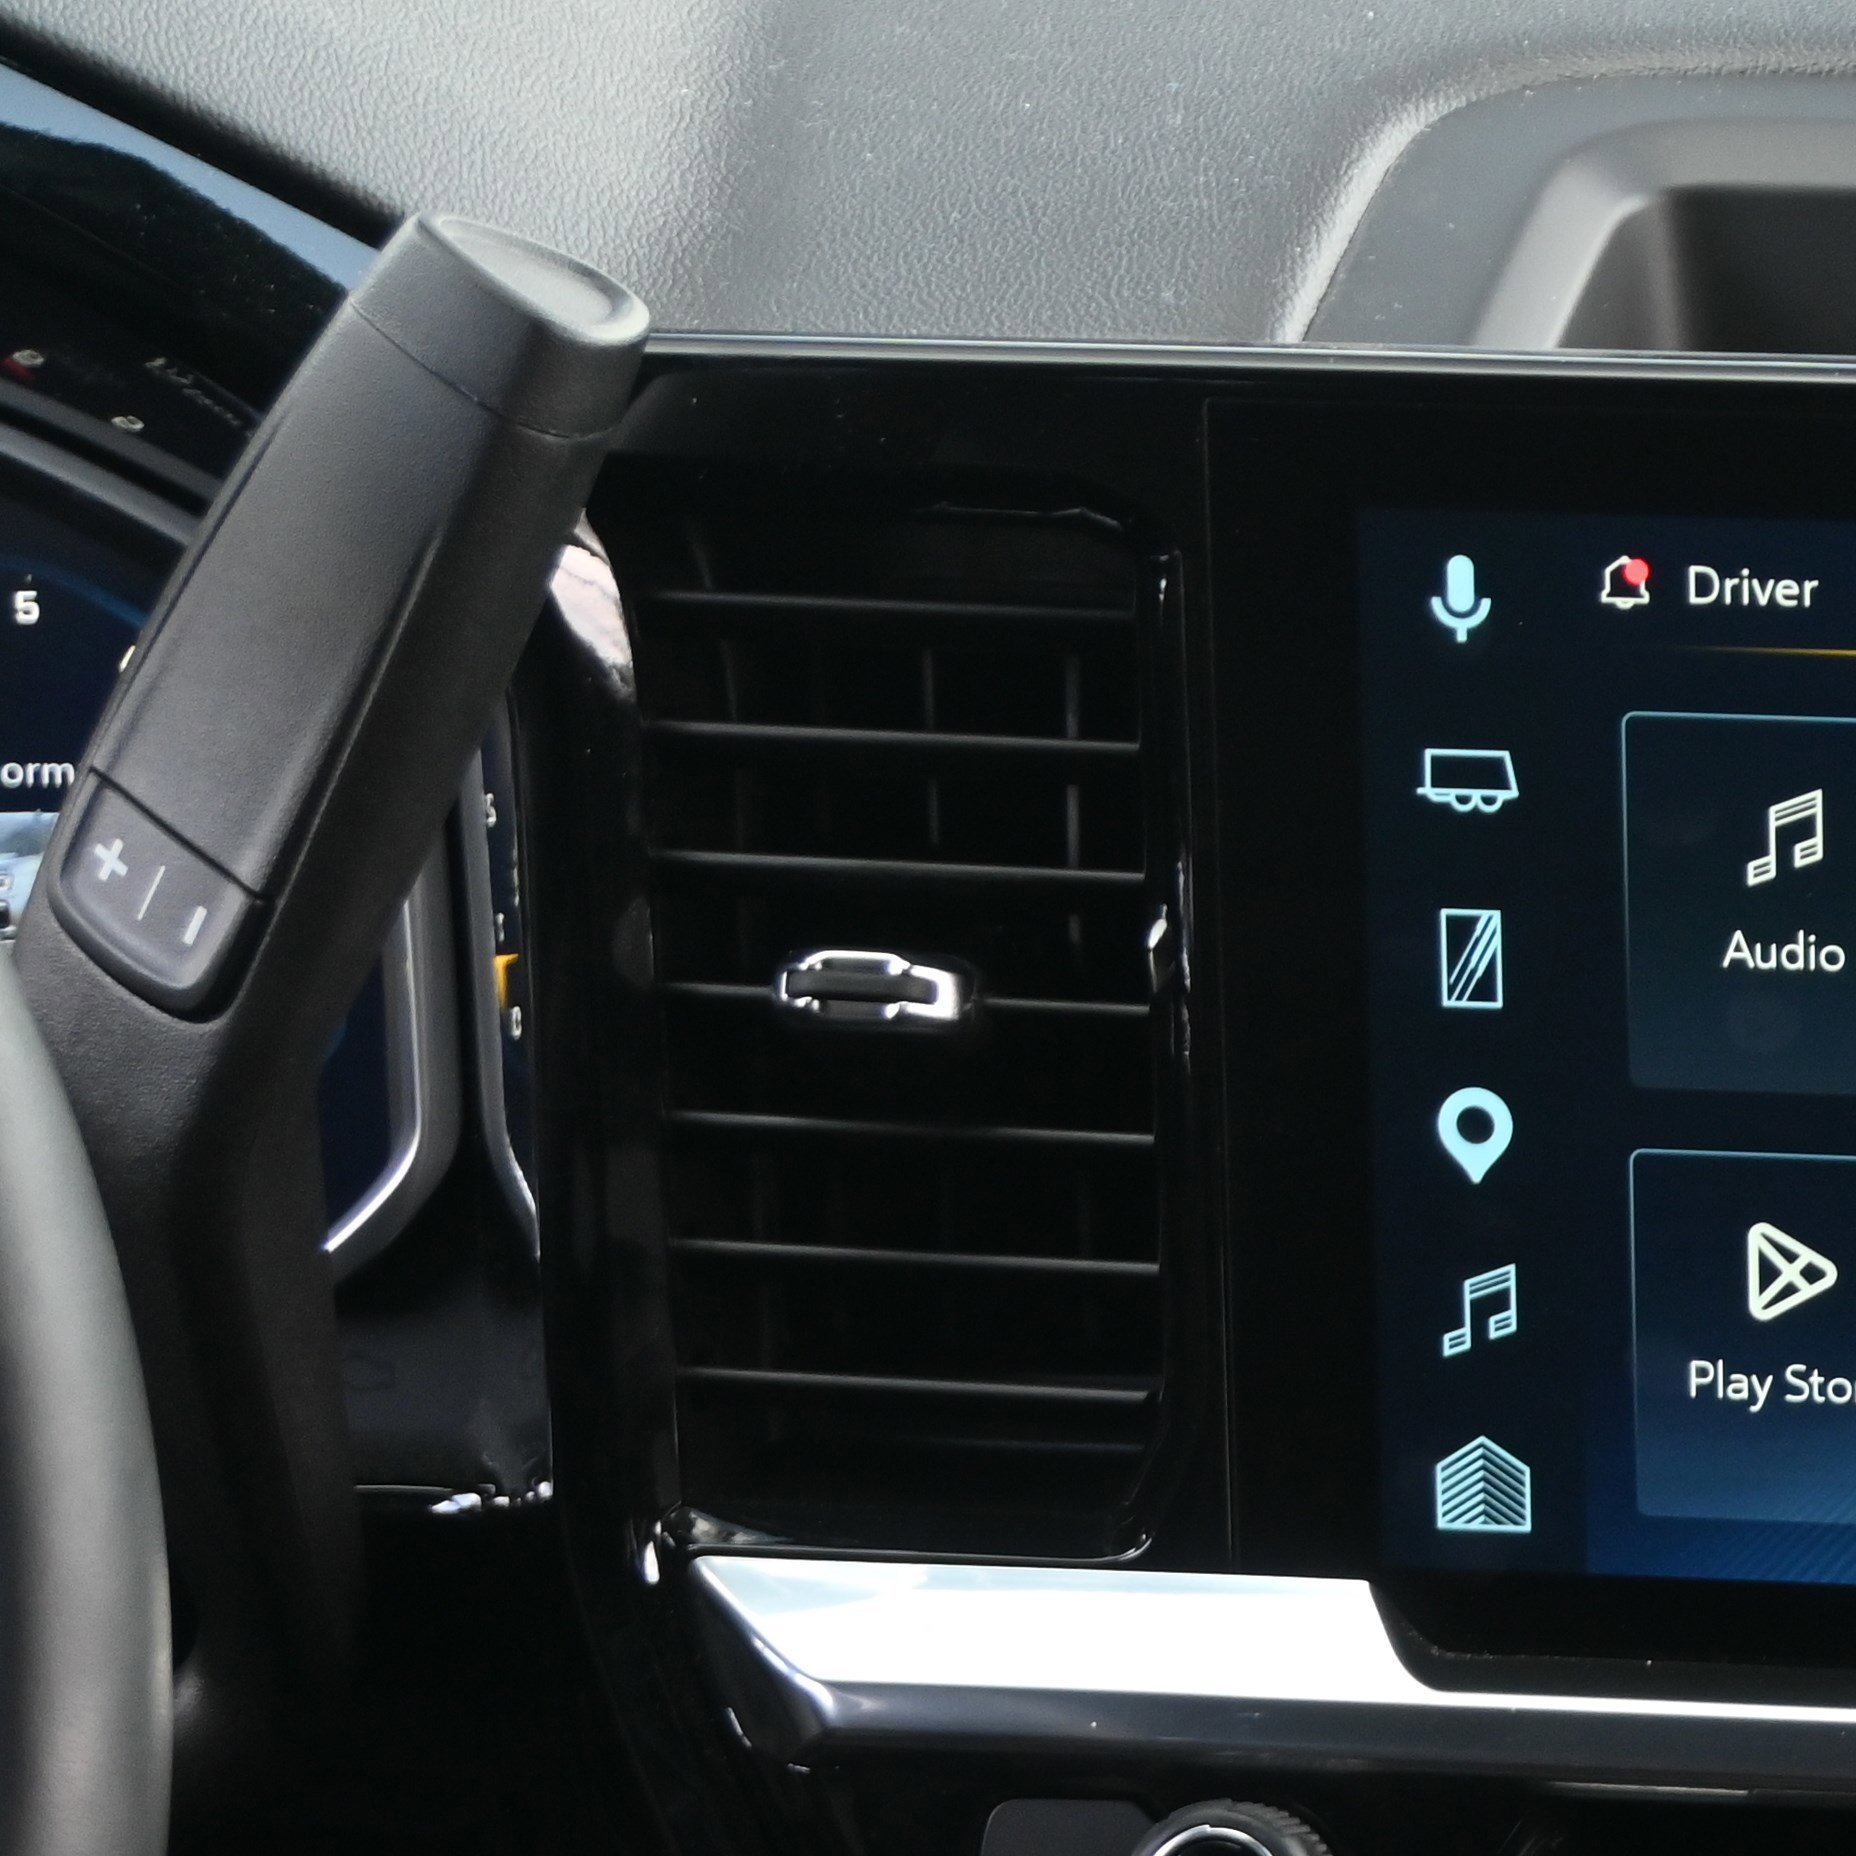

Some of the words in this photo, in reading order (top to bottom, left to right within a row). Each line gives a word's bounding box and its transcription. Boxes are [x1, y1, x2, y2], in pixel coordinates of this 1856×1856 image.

[1687, 564, 1819, 608] Driver
[1721, 929, 1846, 973] Audio
[1688, 1358, 1774, 1413] Play
